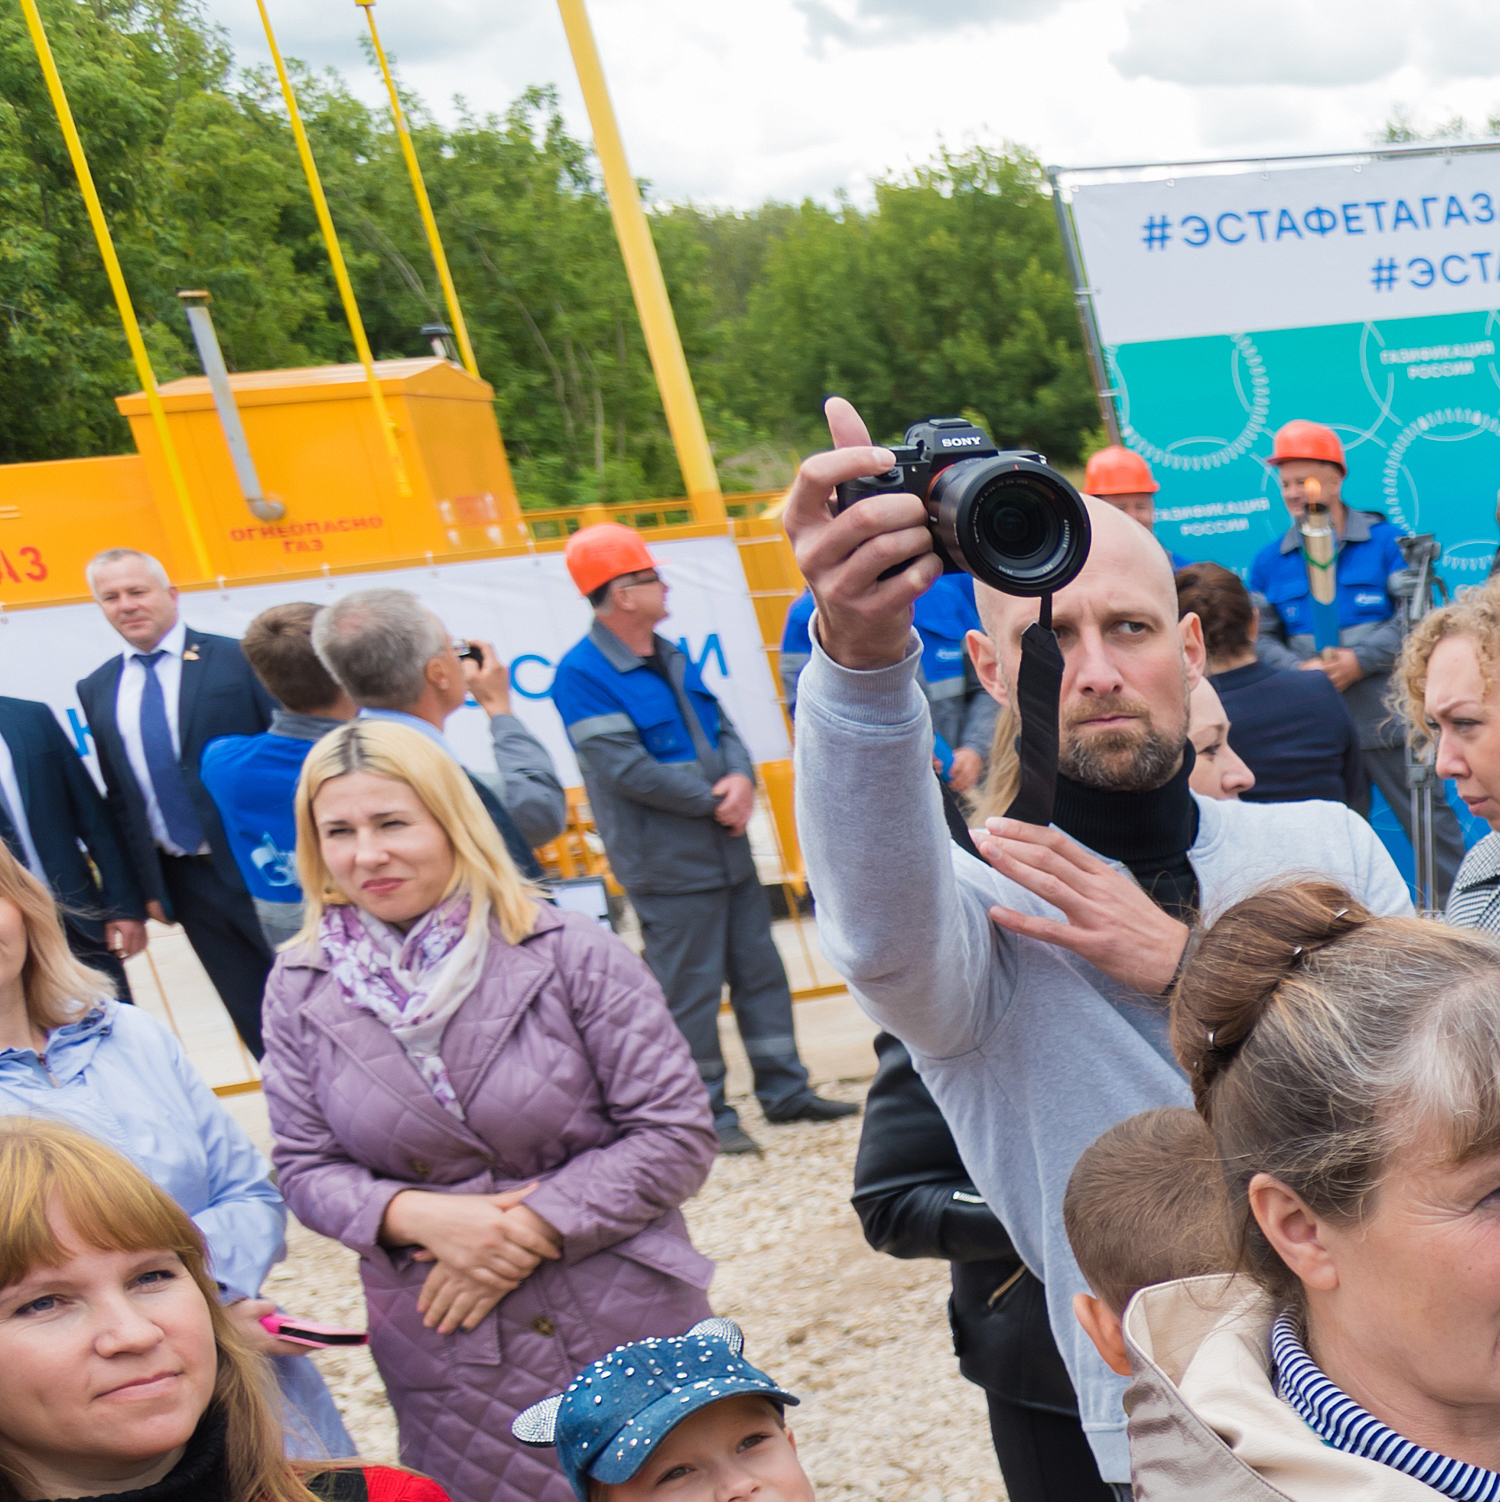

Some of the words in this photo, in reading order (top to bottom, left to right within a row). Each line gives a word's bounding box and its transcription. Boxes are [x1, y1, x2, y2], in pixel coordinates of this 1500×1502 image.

[941, 436, 981, 448] SONY
[229, 515, 384, 543] ОГНЕОПАСНО
[281, 538, 325, 554] ГАЗ
